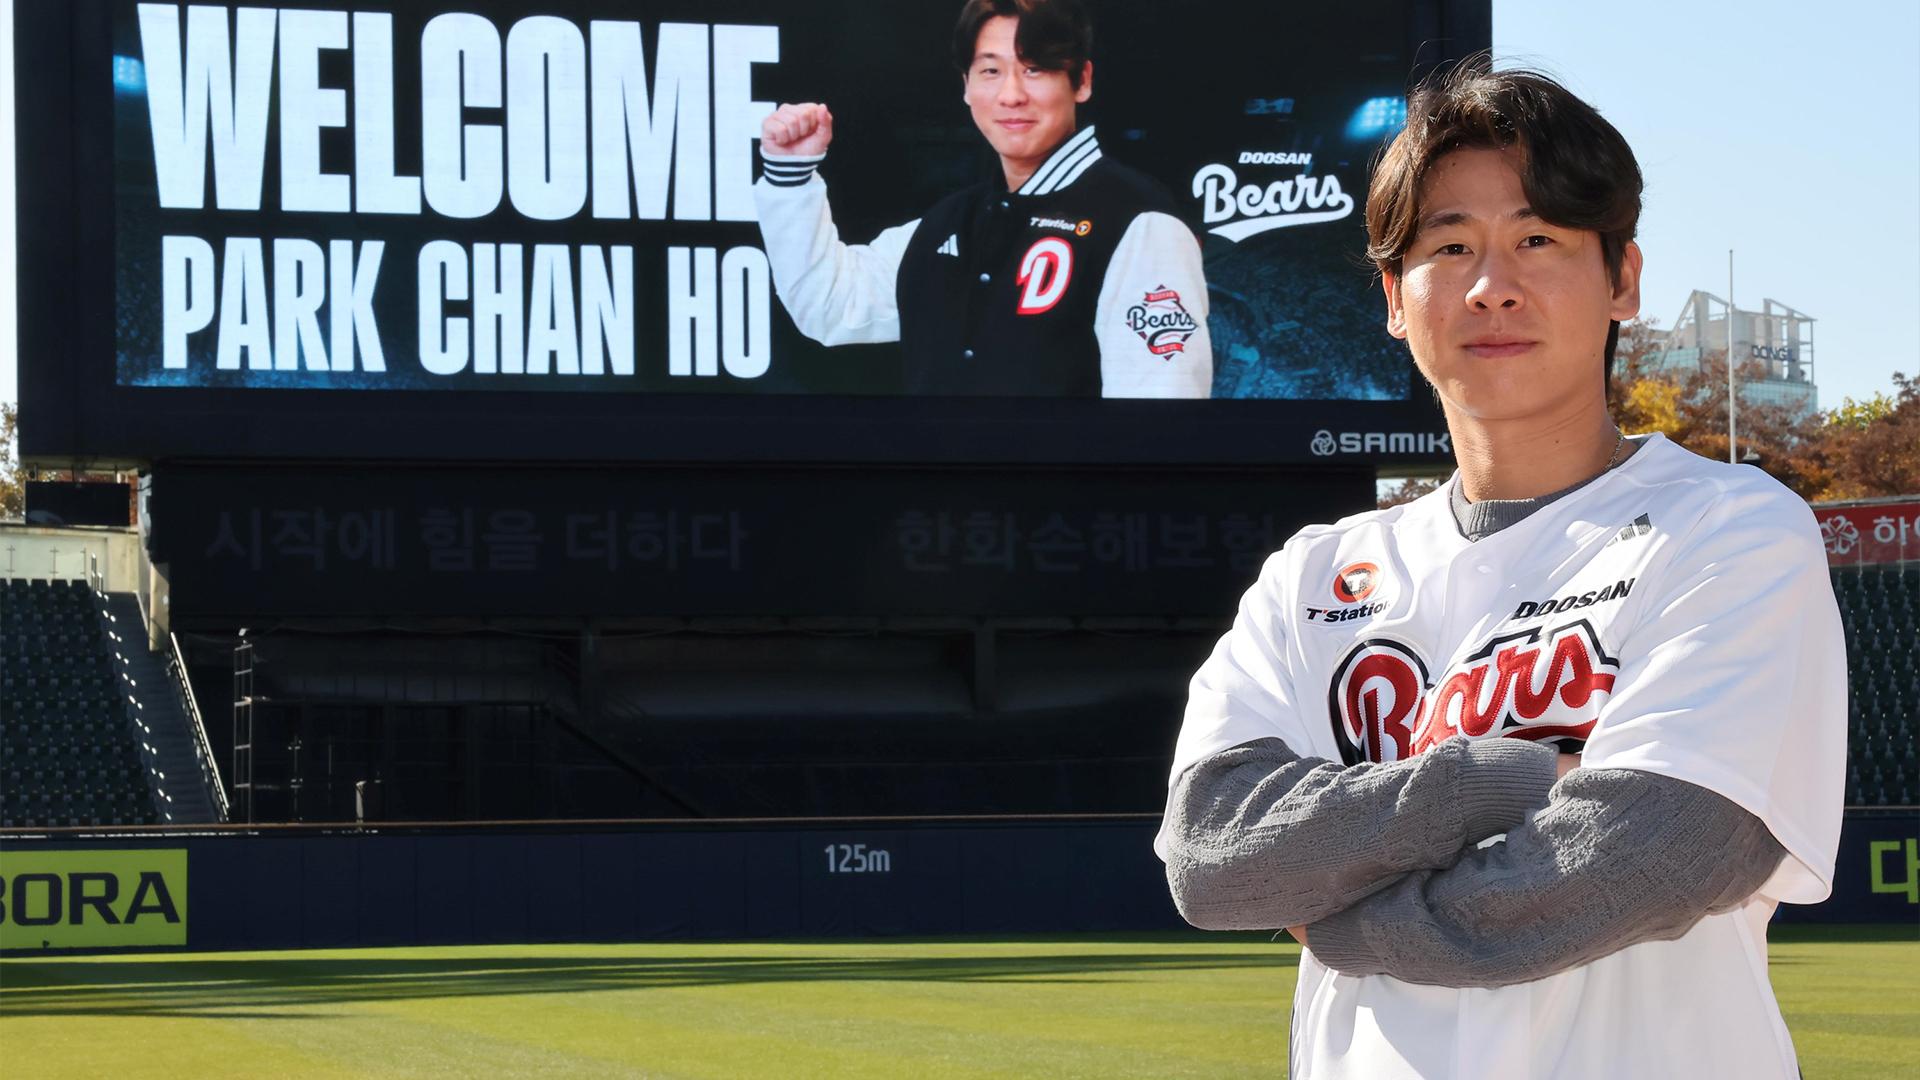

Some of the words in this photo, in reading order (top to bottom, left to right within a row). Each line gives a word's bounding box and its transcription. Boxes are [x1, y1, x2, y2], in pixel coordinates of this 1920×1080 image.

[137, 3, 779, 222] WELCOME
[1238, 151, 1312, 165] DOOSAN
[1192, 163, 1354, 243] Bears
[1016, 236, 1073, 315] D
[162, 235, 387, 373] PARK
[418, 239, 634, 376] CHAN
[667, 246, 772, 379] HO
[1126, 305, 1198, 341] Bears
[1339, 432, 1450, 453] SAMIK
[206, 507, 398, 572] 시작에
[419, 507, 544, 572] 힘을
[564, 509, 750, 571] 더하다
[1873, 515, 1920, 546] 하
[1510, 577, 1636, 620] DOOSAN
[1336, 628, 1619, 765] Bars
[824, 843, 890, 873] 125m
[0, 871, 181, 926] ORA
